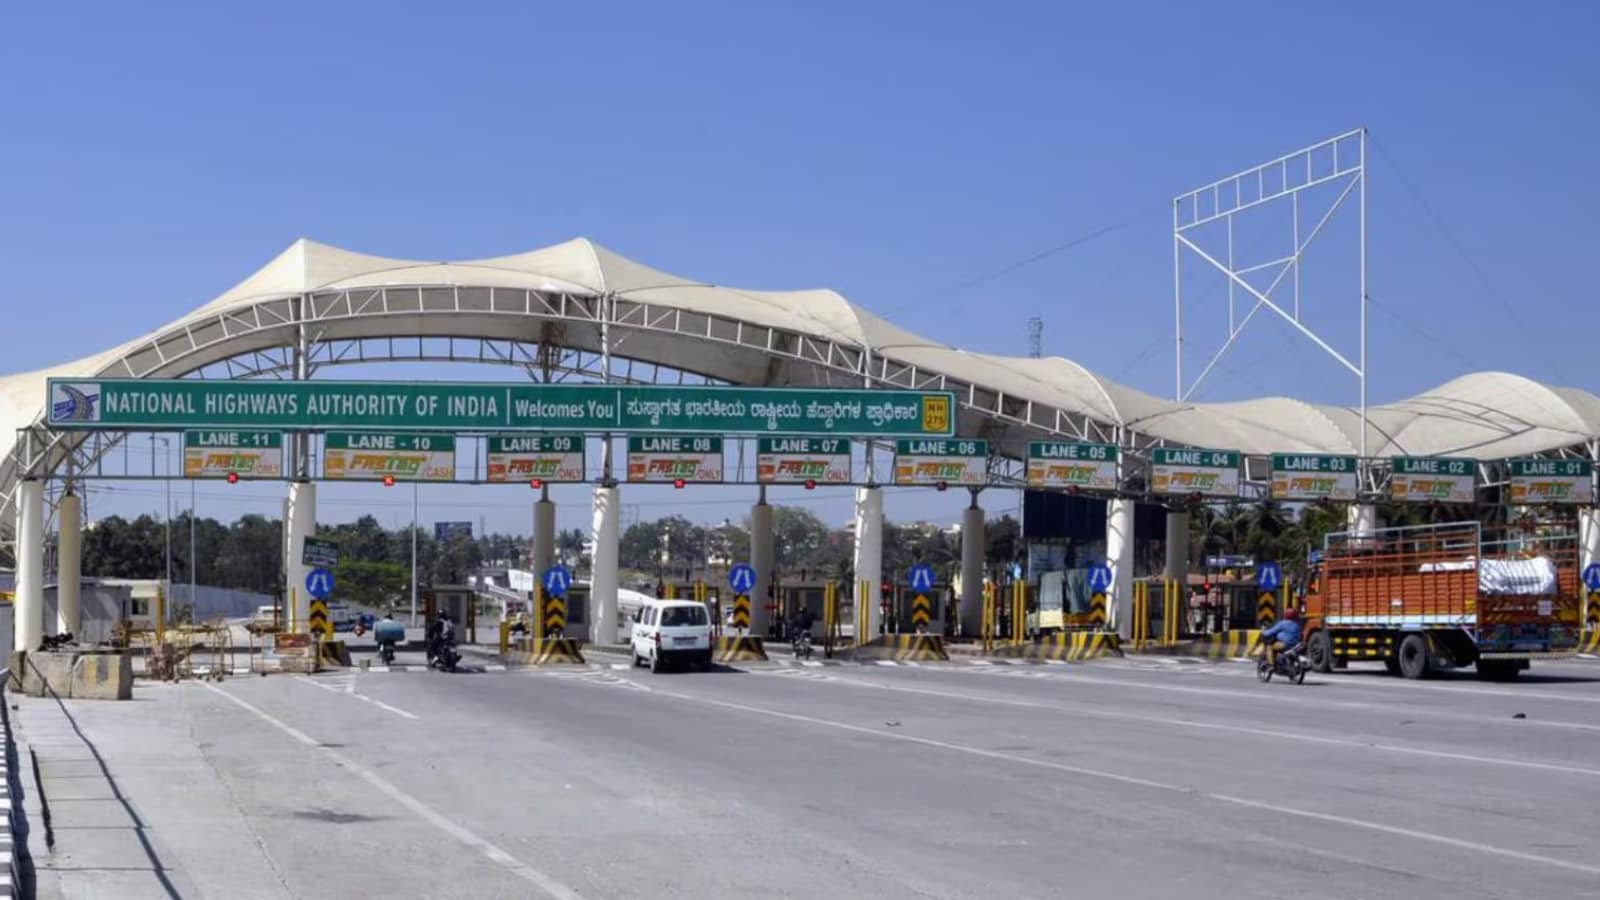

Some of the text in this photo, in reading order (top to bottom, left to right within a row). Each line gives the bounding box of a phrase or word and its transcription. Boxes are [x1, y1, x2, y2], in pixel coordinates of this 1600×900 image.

[105, 392, 498, 417] NATIONAL HIGHWAYS AUTHORITY OF INDIA
[515, 400, 614, 418] Welcomes You
[685, 398, 746, 420] ಭಾರತೀಯ
[751, 400, 802, 430] ರಾಷ್ಟ್ರೀಯ
[806, 400, 862, 429] ಹೆದ್ದಾರಿಗಳ
[866, 402, 918, 427] ಪ್ರಾಧಿಕಾರ
[199, 432, 239, 446] LANE
[252, 433, 269, 446] 11
[347, 435, 396, 449] LANE
[413, 437, 431, 450] 10
[501, 438, 540, 451] LANE
[554, 438, 572, 452] 09
[642, 438, 681, 451] LANE
[693, 438, 711, 452] 08
[771, 440, 809, 452] LANE
[822, 440, 839, 453] 07
[910, 441, 947, 454] LANE
[959, 442, 976, 455] 06
[1041, 445, 1079, 458] LANE
[1089, 446, 1107, 459] 05
[1165, 451, 1201, 465] LANE
[1212, 453, 1229, 466] 04
[1284, 457, 1320, 470] LANE
[1330, 458, 1347, 471] 03
[1404, 459, 1440, 473] LANE
[1449, 461, 1465, 474] 02
[1522, 462, 1557, 475] LANE
[1567, 463, 1582, 475] 01
